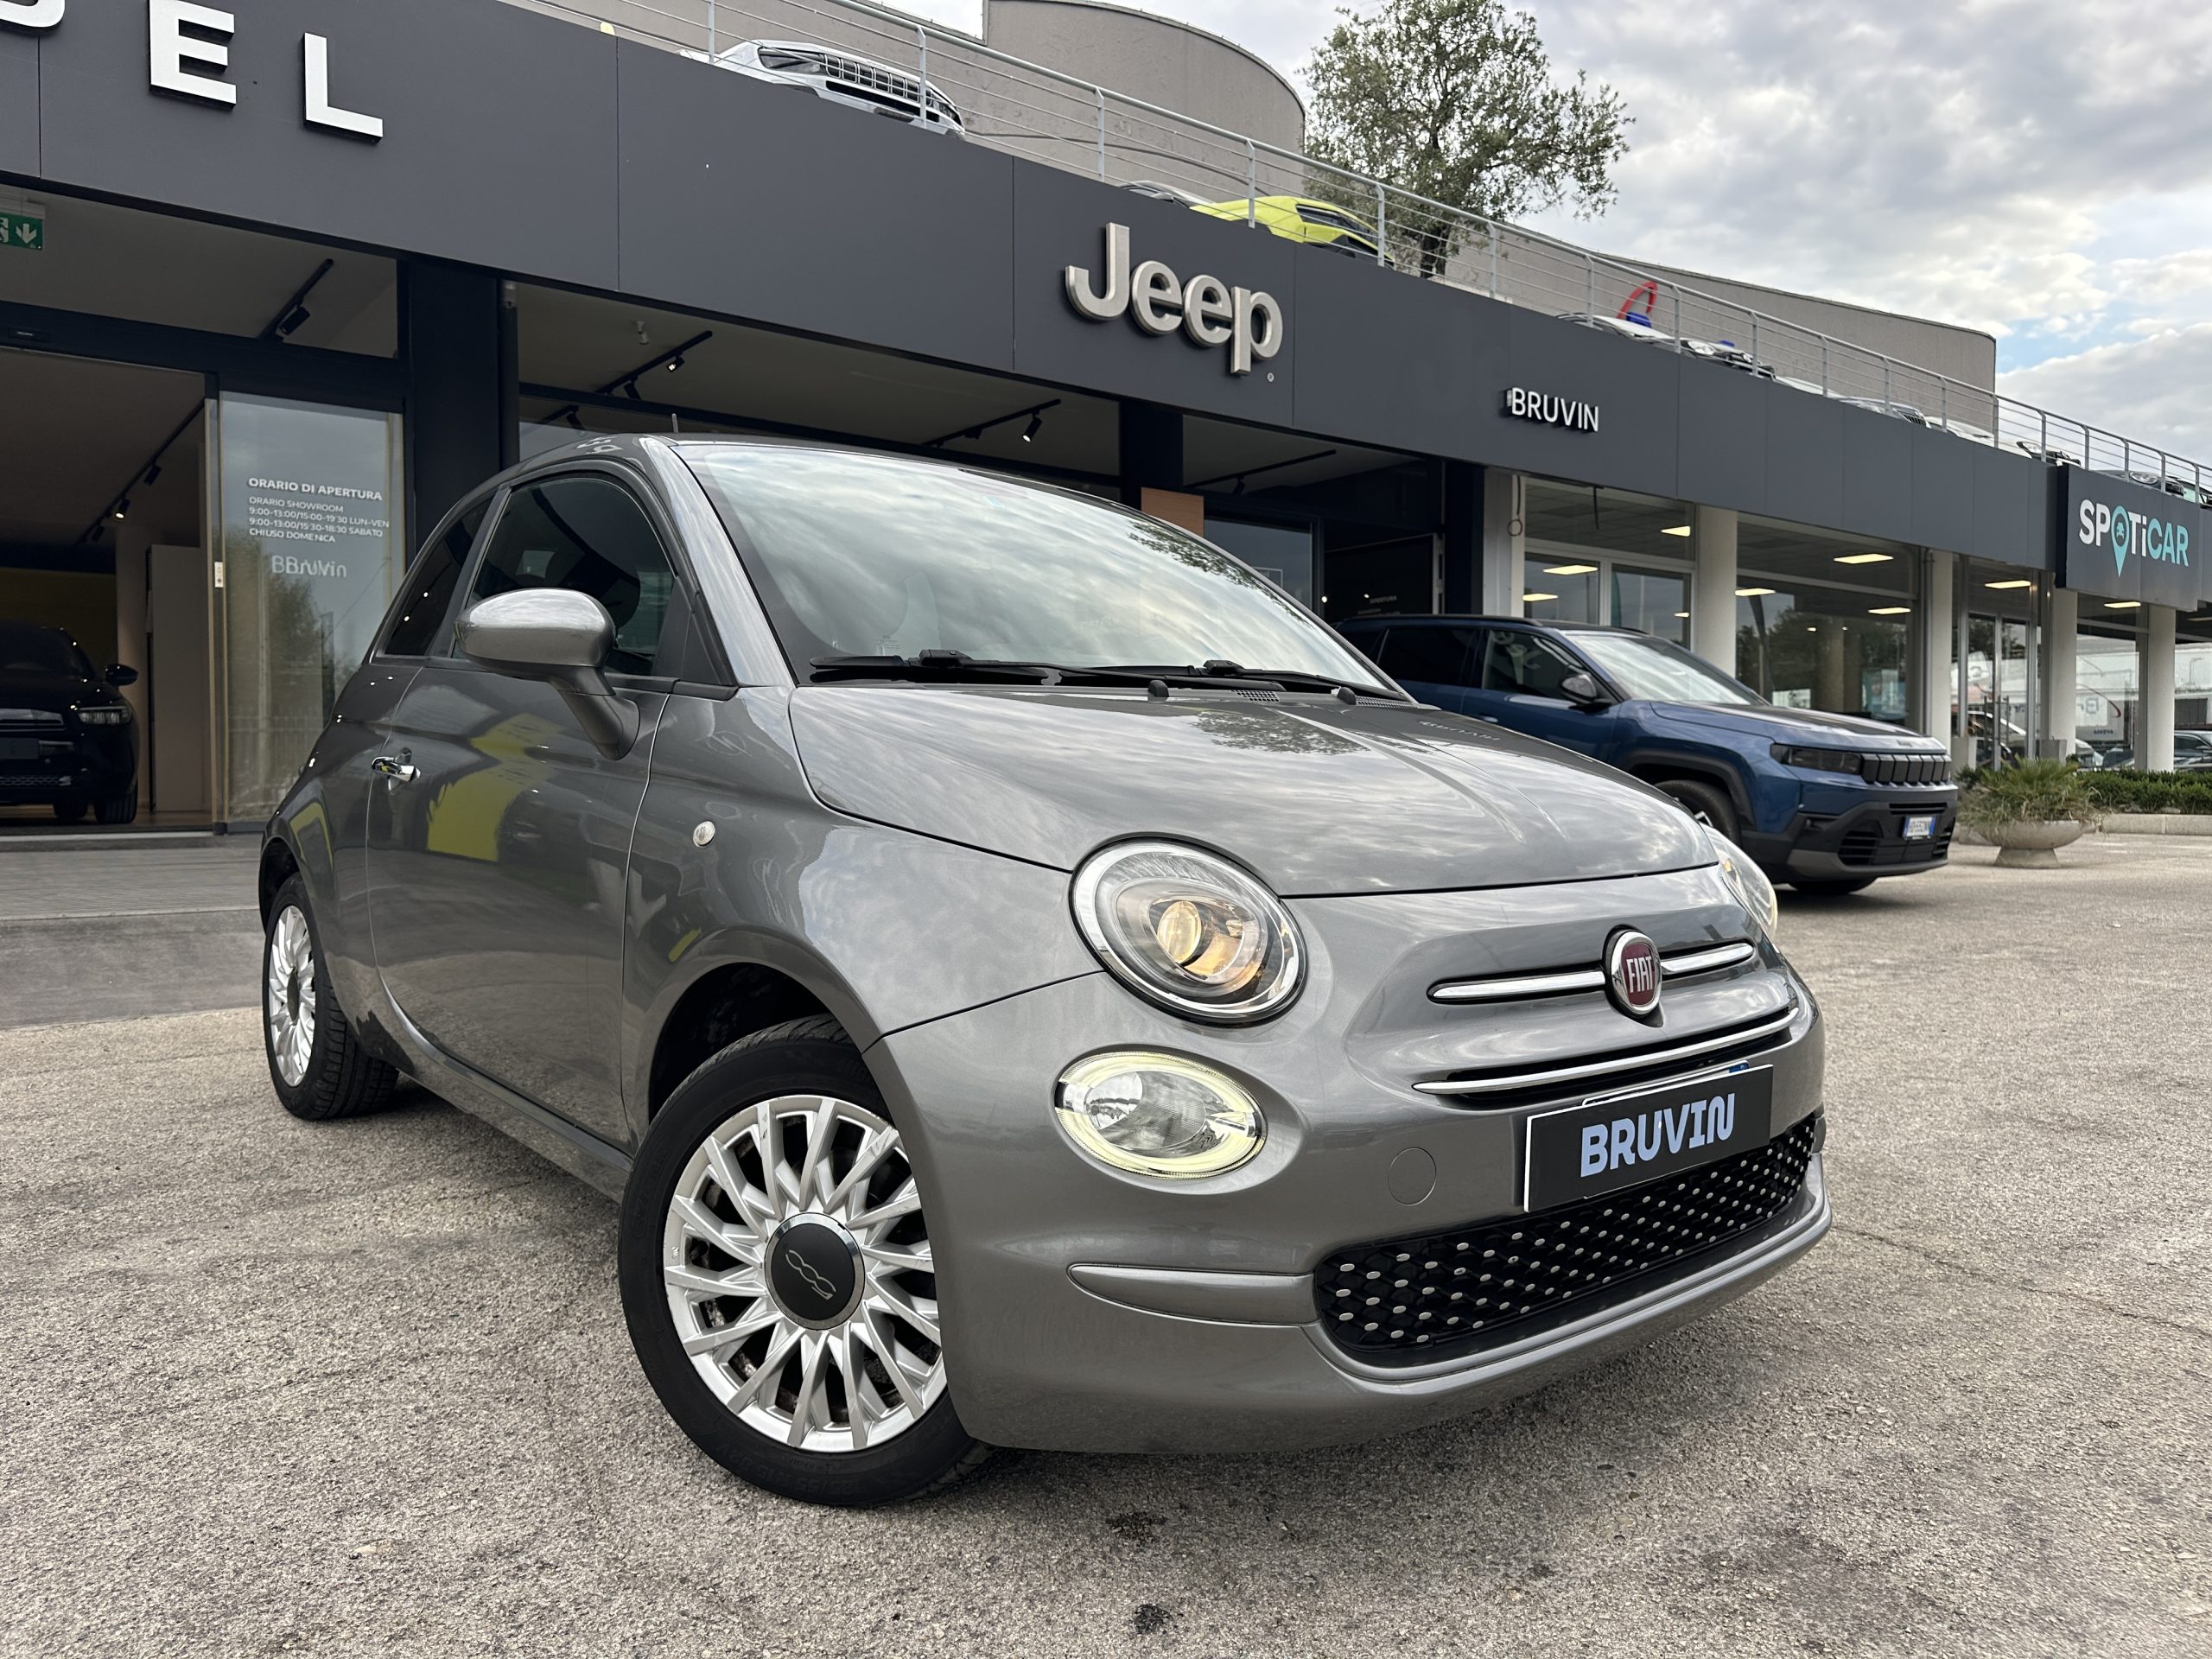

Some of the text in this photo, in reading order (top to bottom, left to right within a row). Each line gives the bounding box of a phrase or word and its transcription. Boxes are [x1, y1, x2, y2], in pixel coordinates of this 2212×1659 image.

[1065, 222, 1284, 376] Jeep
[1510, 387, 1599, 432] BRUVIN
[248, 477, 383, 501] ORARIO DI APERTURA
[249, 496, 344, 513] ORARIO SHOWROOM
[249, 527, 285, 539] CHIUSO
[348, 527, 384, 538] SABATO
[349, 517, 390, 529] LUN-VEN
[1625, 955, 1652, 994] FIAT
[1580, 1093, 1735, 1178] BRUVIN
